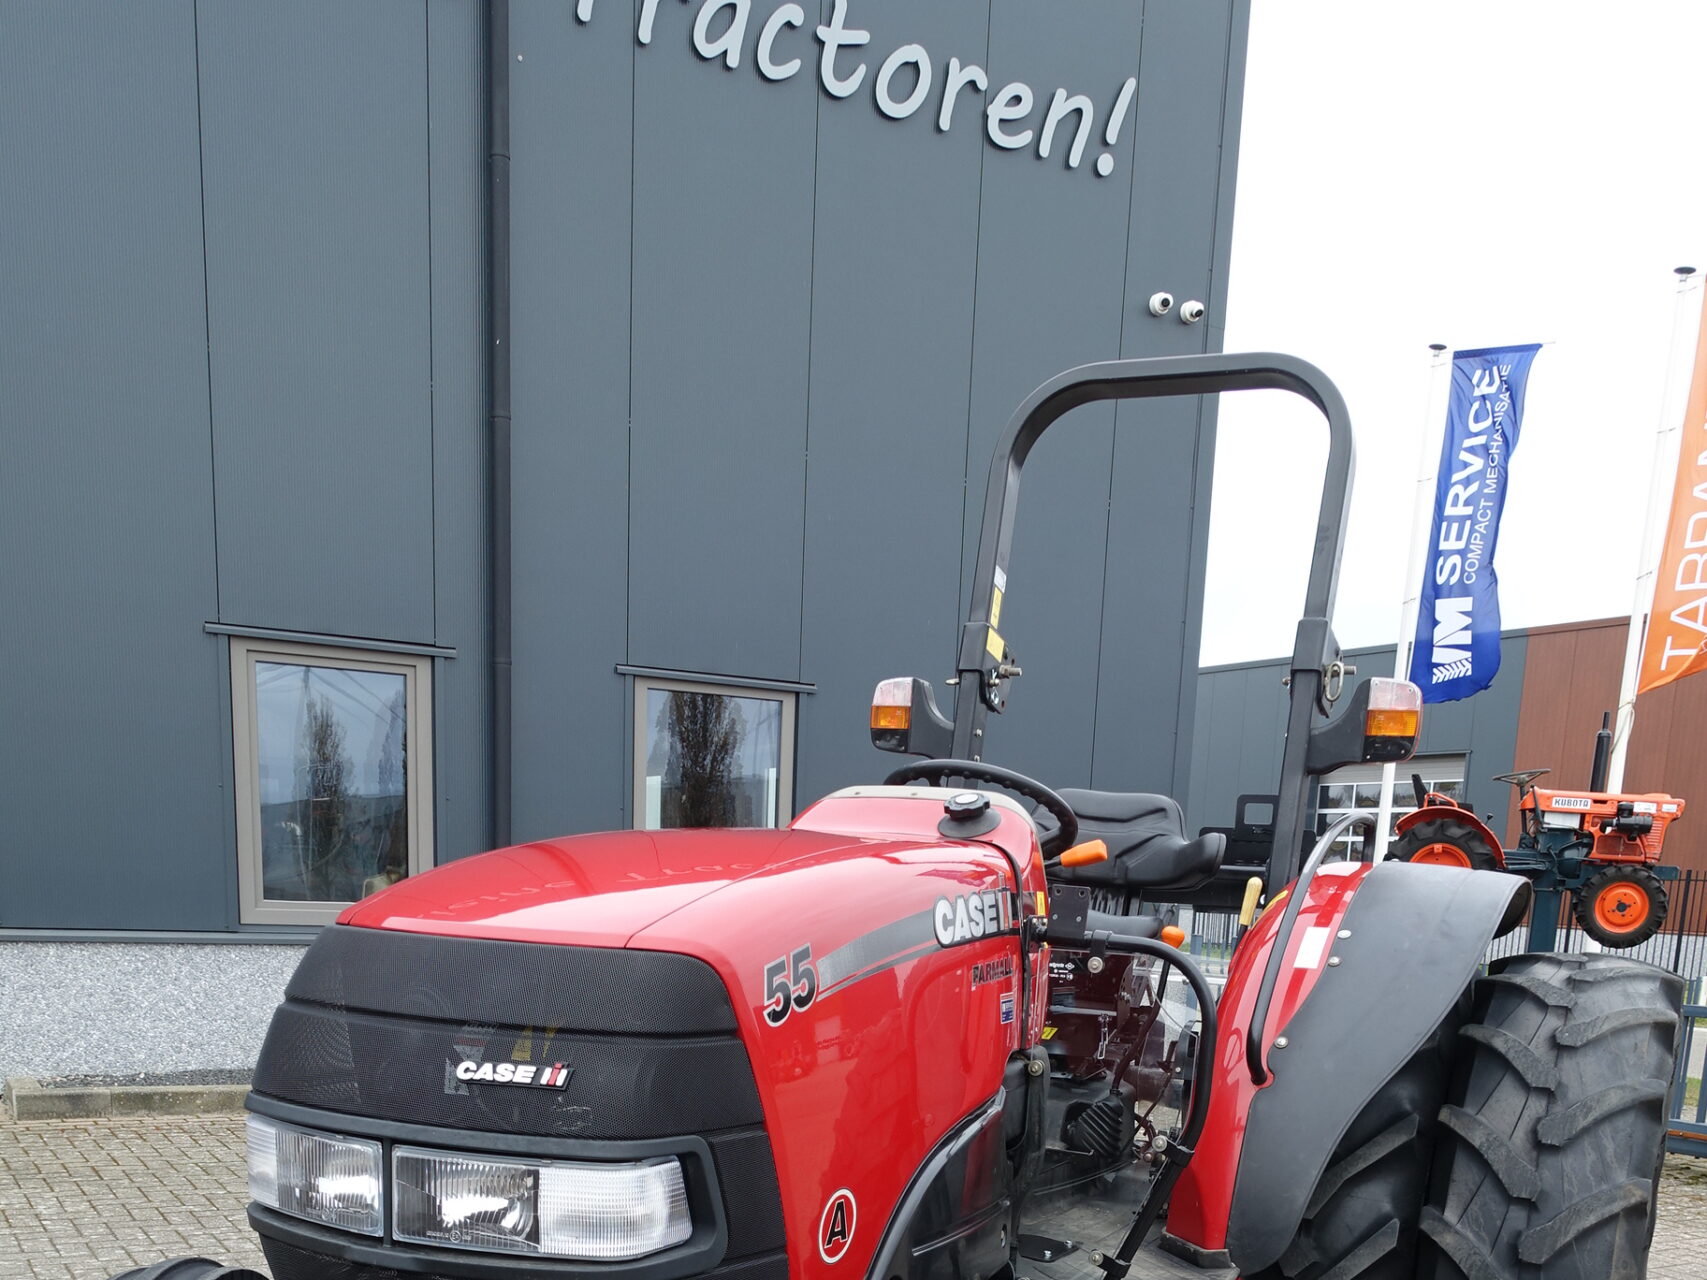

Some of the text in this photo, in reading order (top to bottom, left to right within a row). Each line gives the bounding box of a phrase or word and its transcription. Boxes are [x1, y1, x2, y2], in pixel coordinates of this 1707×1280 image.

[1436, 365, 1501, 585] SERVICE
[1463, 364, 1512, 584] COMPACT MECHANISATIE
[1554, 798, 1589, 808] KUBOTA
[934, 890, 997, 946] CASE
[763, 944, 817, 1028] 55
[972, 956, 1012, 986] FARMALL
[456, 1061, 537, 1084] CASE
[823, 1201, 849, 1249] A
